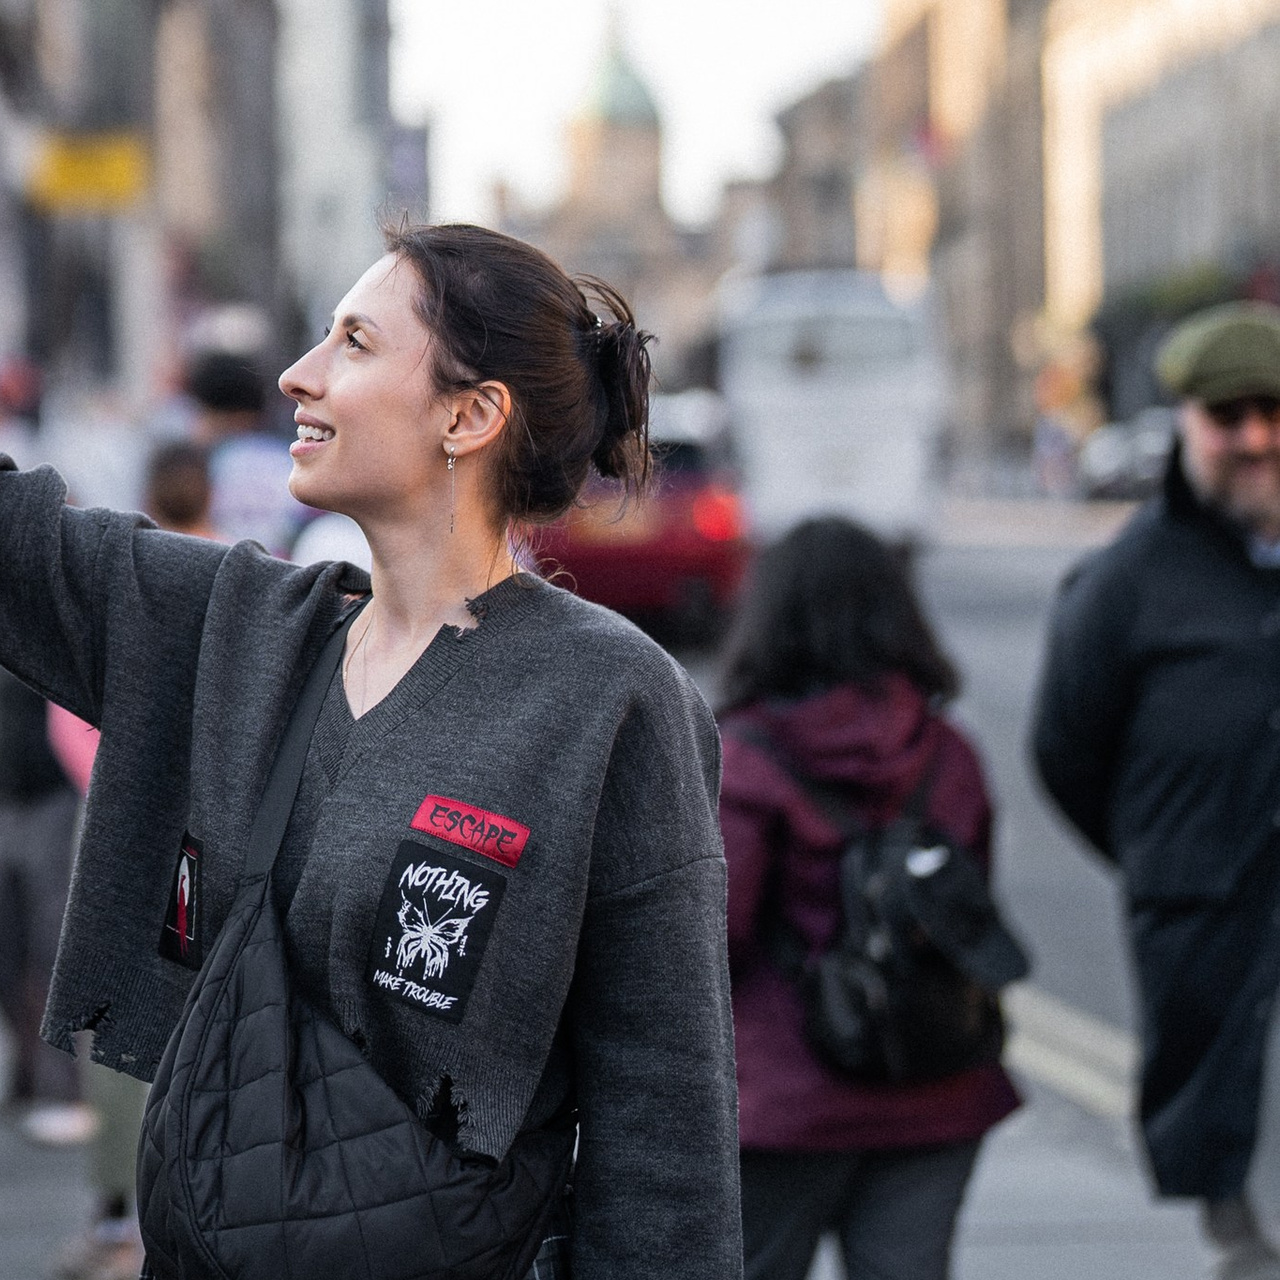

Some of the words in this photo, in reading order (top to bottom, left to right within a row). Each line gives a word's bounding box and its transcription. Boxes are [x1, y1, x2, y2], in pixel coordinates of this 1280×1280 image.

[429, 803, 518, 856] ESCAPE
[398, 861, 490, 915] NOTHING
[373, 969, 405, 991] MAKE
[402, 980, 458, 1010] TROUBLE
